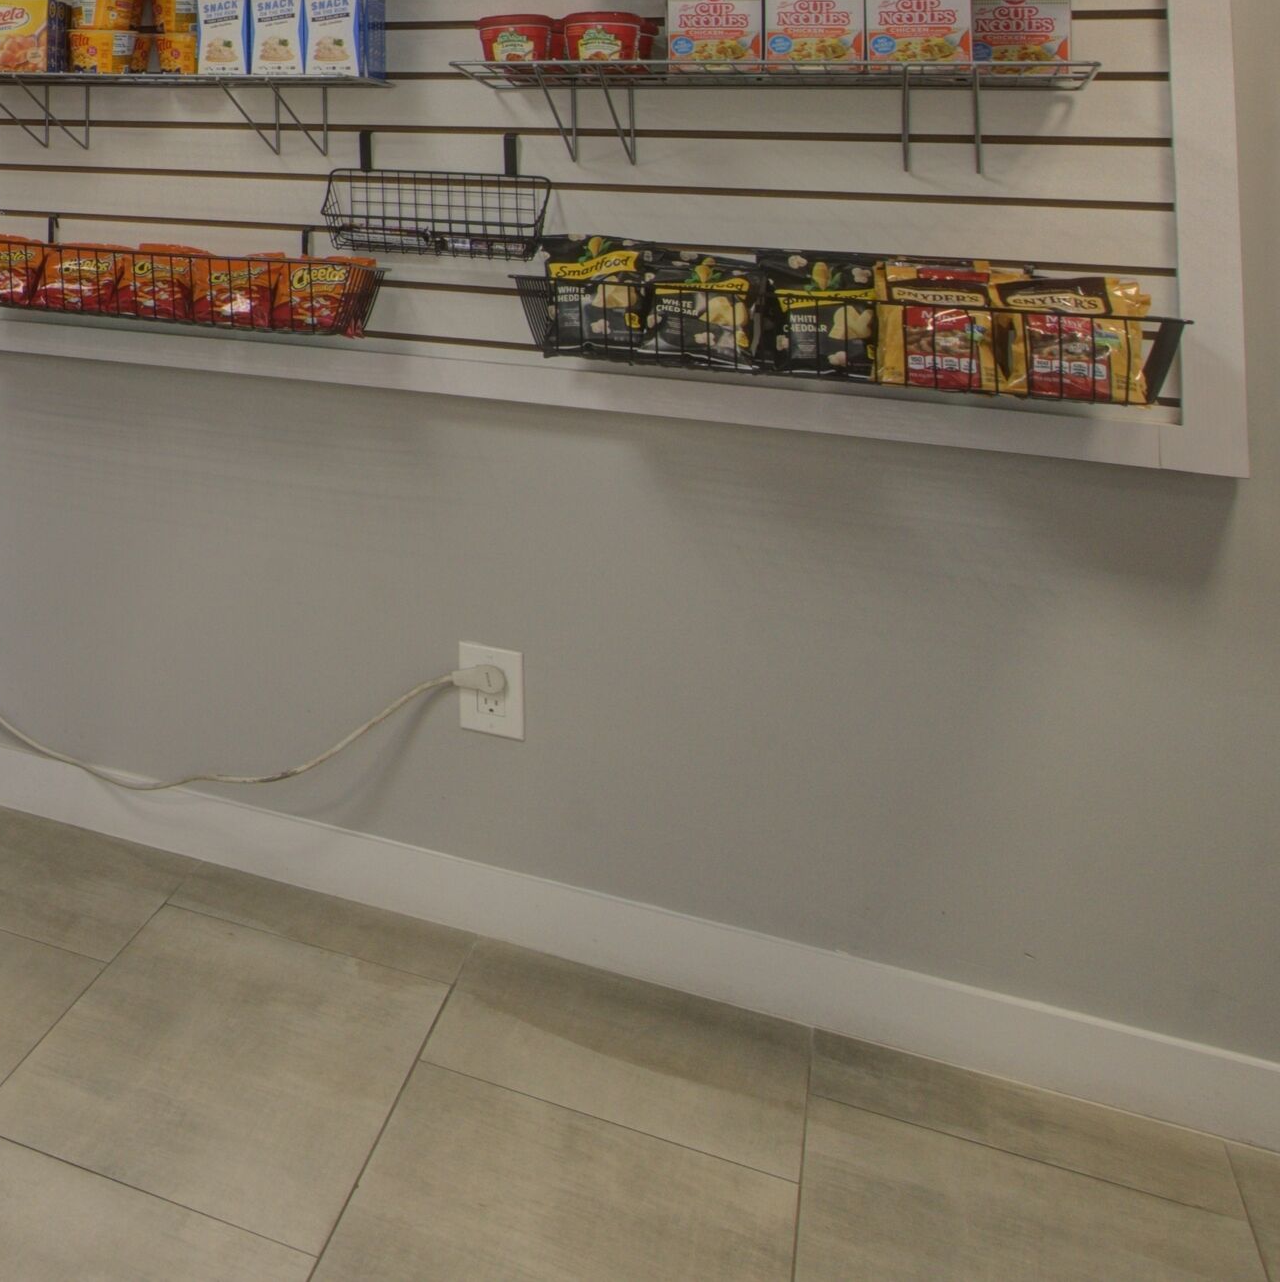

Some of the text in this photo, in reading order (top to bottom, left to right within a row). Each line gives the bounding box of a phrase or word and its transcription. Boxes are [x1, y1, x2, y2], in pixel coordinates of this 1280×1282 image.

[203, 1, 238, 13] SNACK
[695, 2, 735, 16] CUP
[793, 0, 835, 14] CUP
[991, 6, 1038, 20] CUP
[679, 14, 749, 28] NOODLES
[776, 12, 851, 26] NOODLES
[878, 11, 957, 26] NOODLES
[975, 18, 1054, 33] NOODLES
[556, 256, 630, 278] Smartfood
[292, 267, 346, 289] Cheetos
[558, 286, 586, 294] WHITE
[897, 289, 979, 303] SNYDER'S
[553, 294, 591, 303] HEDDAR
[790, 315, 817, 323] WHIT
